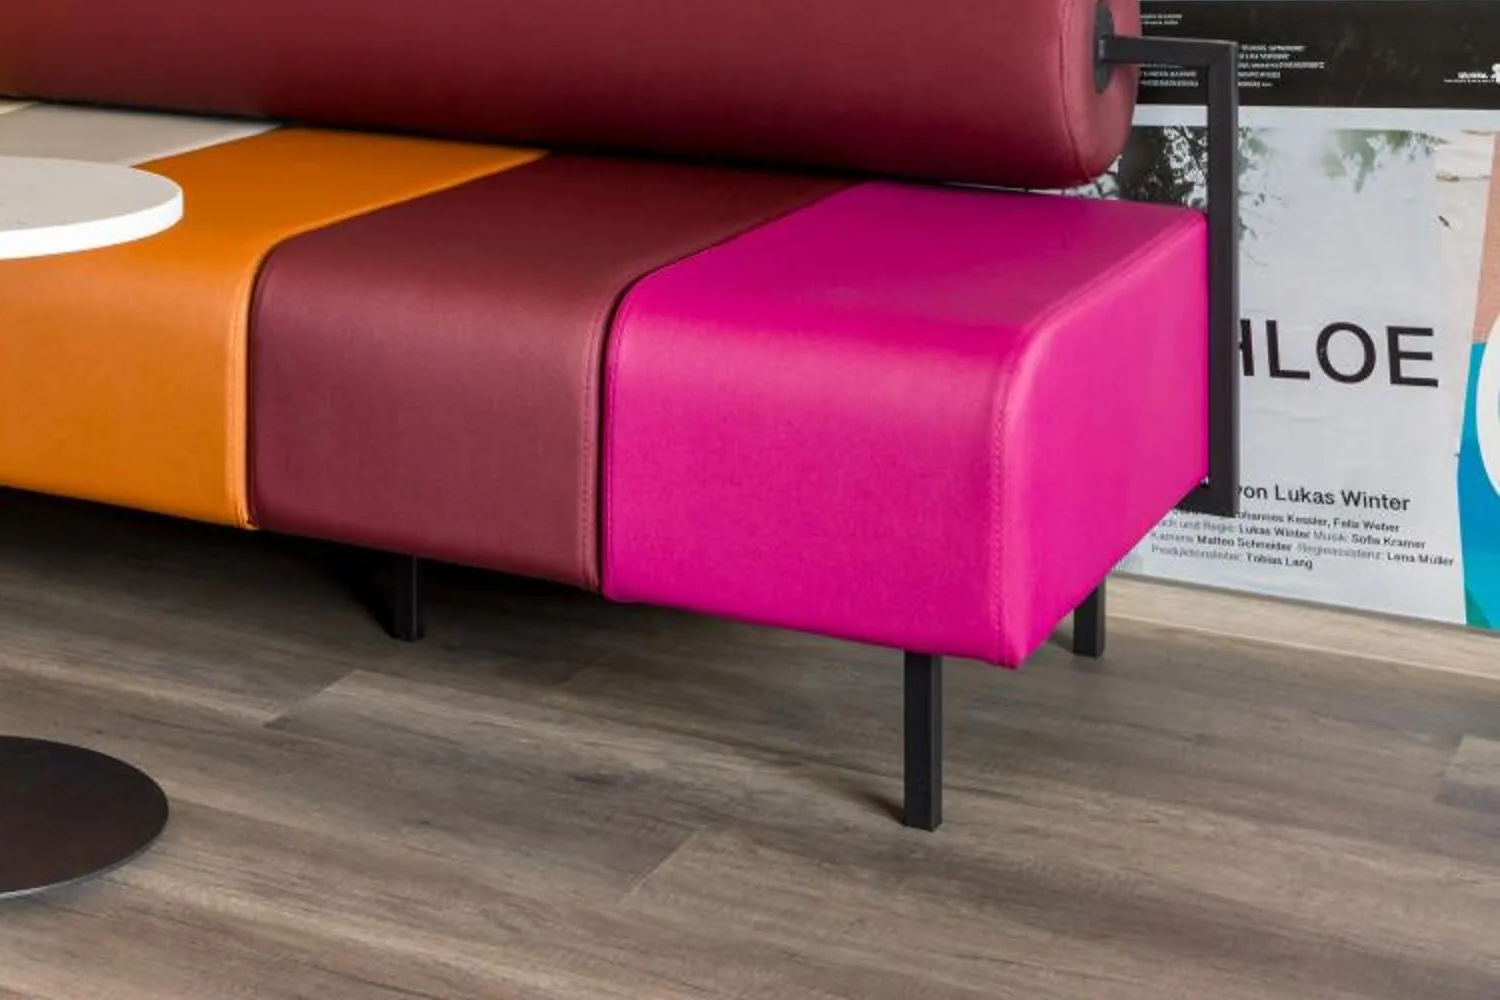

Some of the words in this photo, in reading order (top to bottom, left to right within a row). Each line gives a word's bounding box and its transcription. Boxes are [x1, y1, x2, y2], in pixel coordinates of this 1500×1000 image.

[1275, 484, 1335, 505] Lukas
[1341, 489, 1411, 512] Winter
[1285, 557, 1313, 570] Lang
